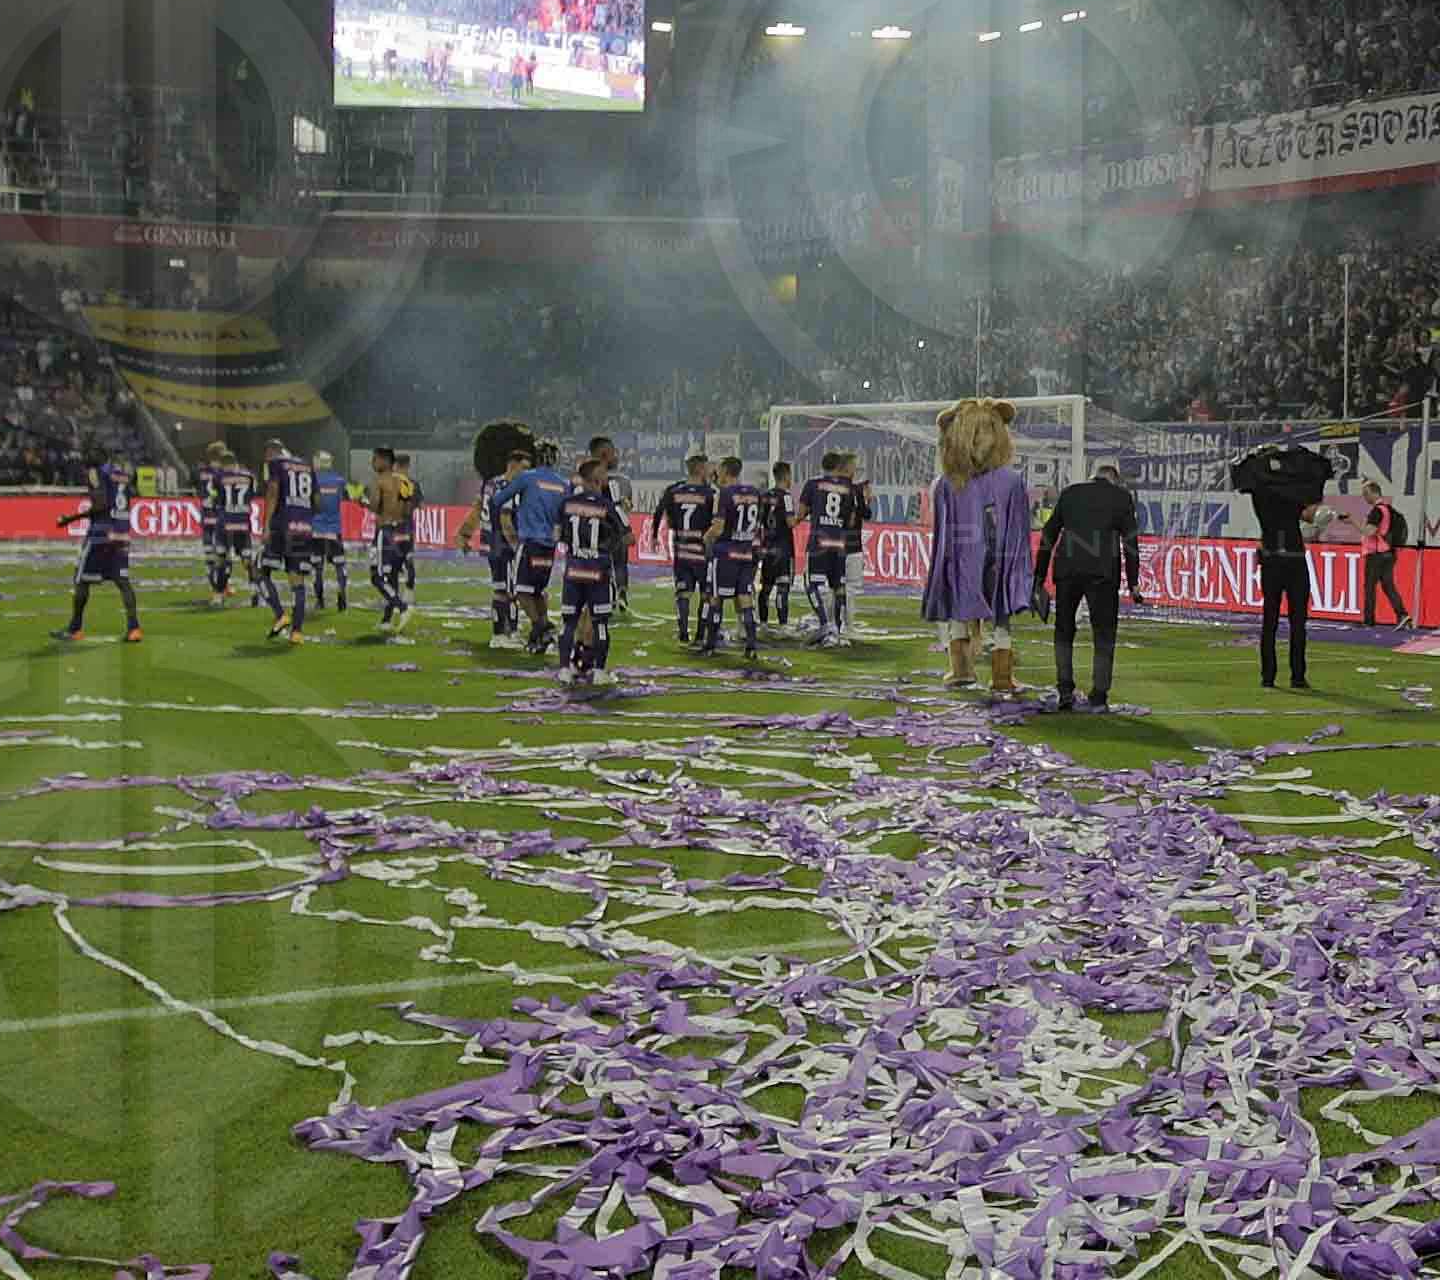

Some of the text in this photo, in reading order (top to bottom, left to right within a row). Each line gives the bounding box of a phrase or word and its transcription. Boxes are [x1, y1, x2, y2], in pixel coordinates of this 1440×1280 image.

[142, 224, 240, 248] GENERALI
[1135, 433, 1221, 454] SEKTION
[1136, 462, 1219, 489] JUNGE
[679, 503, 697, 530] 7
[824, 492, 842, 517] 8
[568, 515, 600, 554] 11
